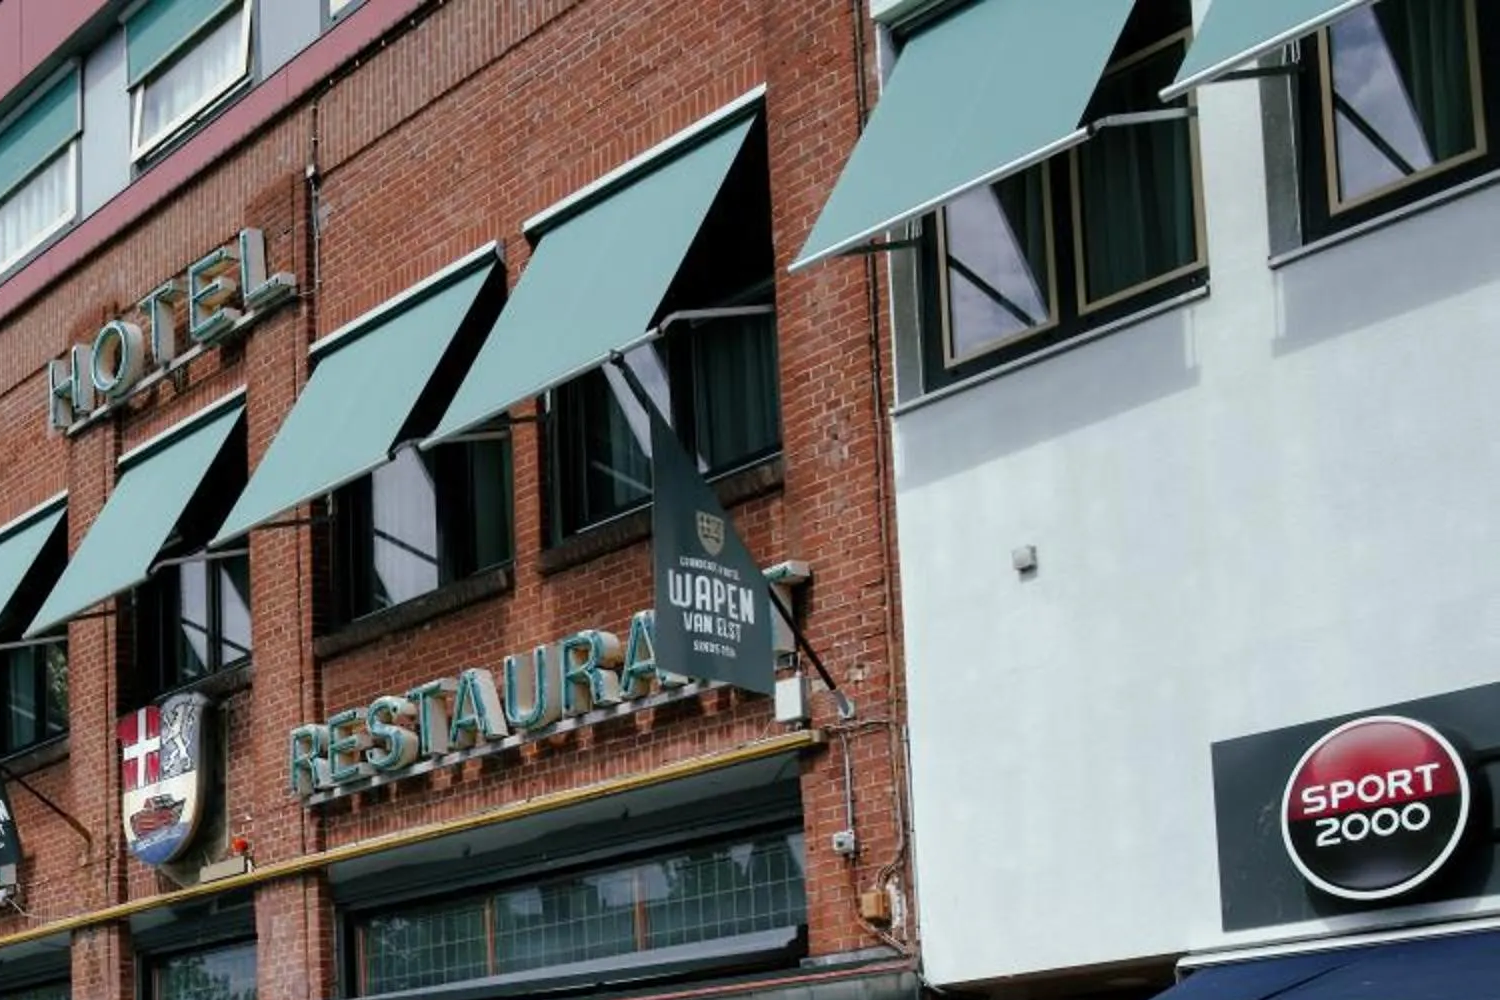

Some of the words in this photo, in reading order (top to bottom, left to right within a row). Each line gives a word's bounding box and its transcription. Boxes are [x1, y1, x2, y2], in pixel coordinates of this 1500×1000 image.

[50, 227, 296, 429] HOTEL
[668, 568, 755, 625] WAPEN
[683, 611, 713, 634] VAN
[717, 617, 742, 643] ELST
[290, 558, 812, 798] RESTAURA
[1301, 763, 1441, 814] SPORT
[1315, 802, 1431, 847] 2000
